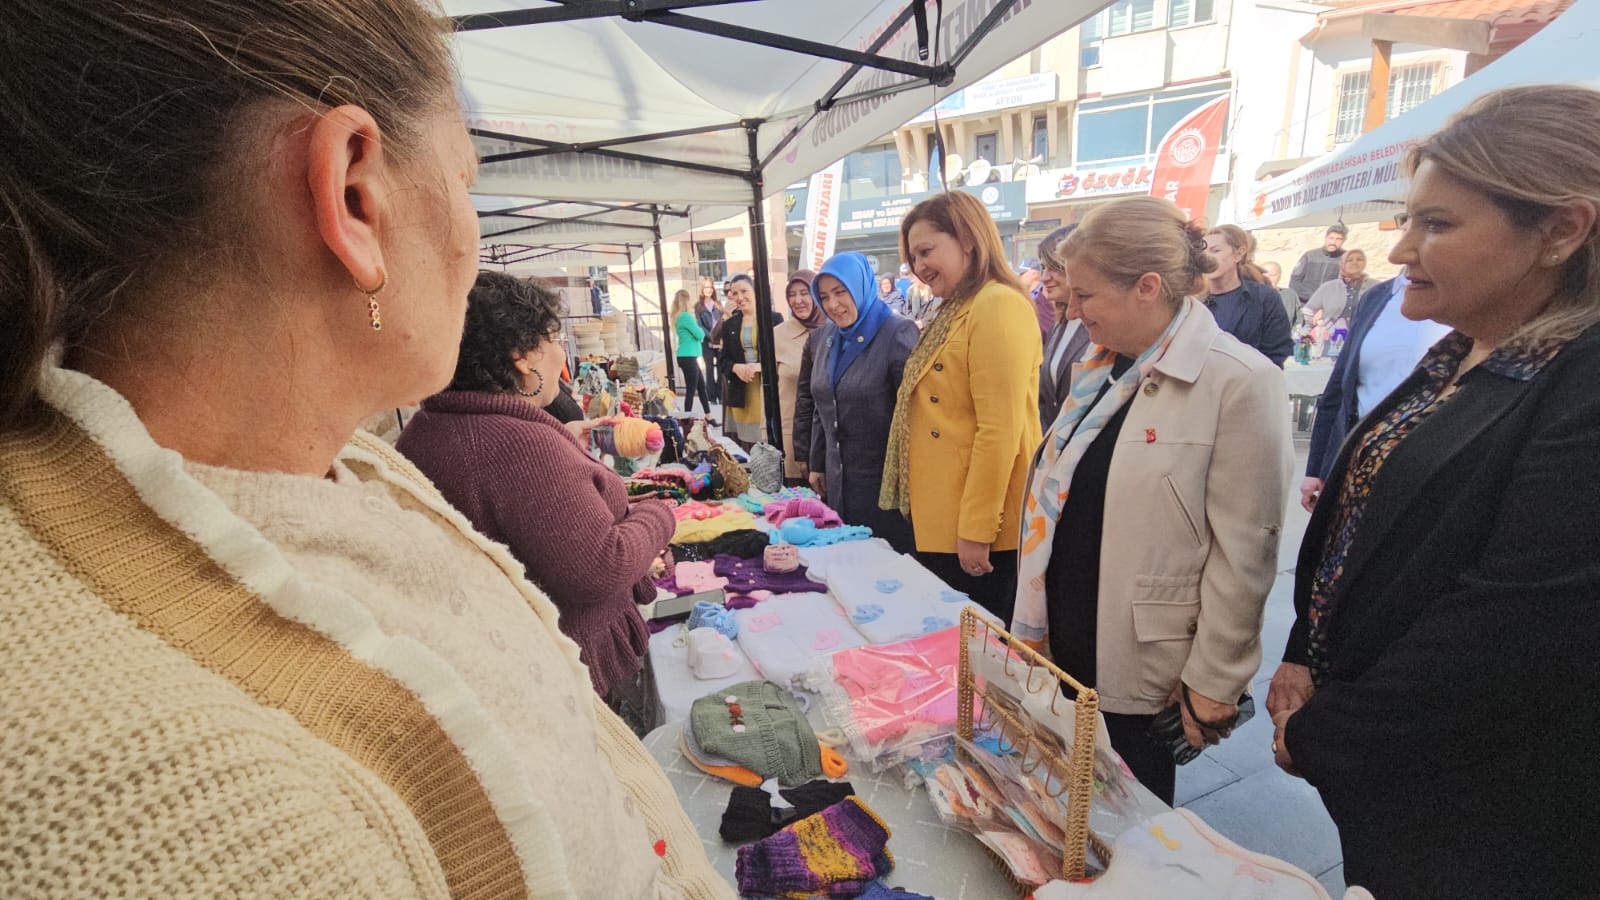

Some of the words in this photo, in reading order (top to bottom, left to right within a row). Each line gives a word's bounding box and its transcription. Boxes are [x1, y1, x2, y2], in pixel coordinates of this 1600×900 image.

[818, 173, 834, 228] PAZARI
[1292, 189, 1303, 207] VE
[1372, 162, 1400, 186] MÜD
